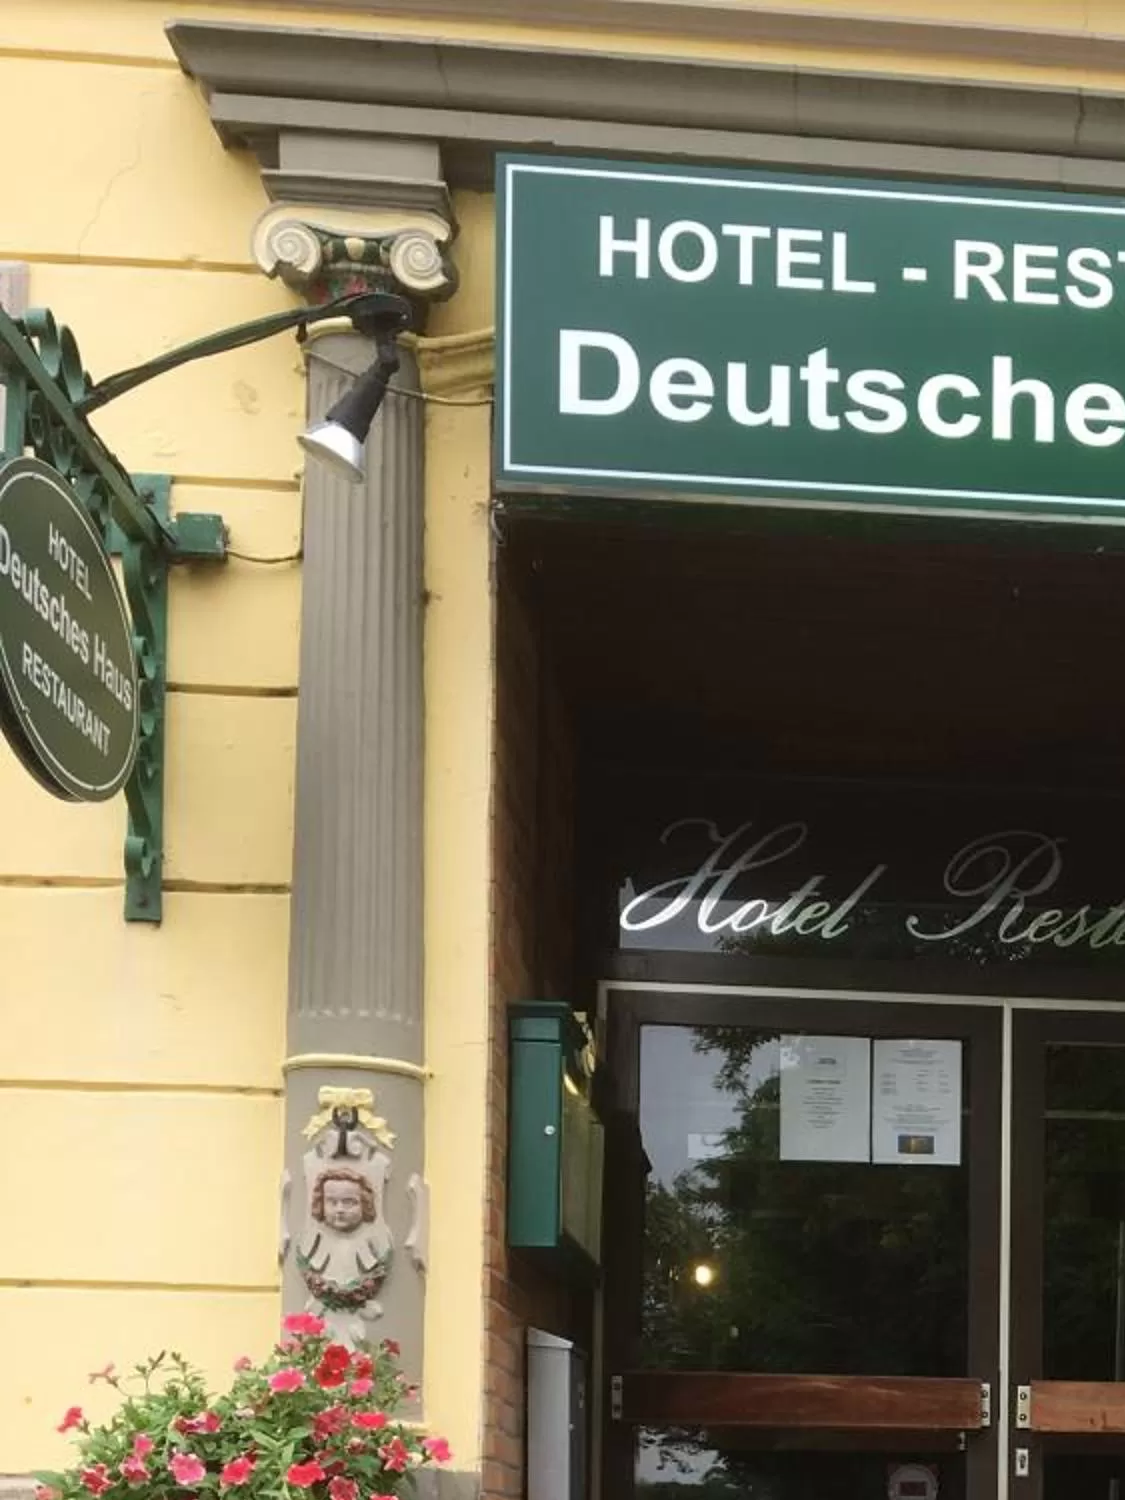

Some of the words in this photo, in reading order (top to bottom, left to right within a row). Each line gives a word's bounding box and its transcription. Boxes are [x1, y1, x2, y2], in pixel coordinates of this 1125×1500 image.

[597, 214, 876, 295] HOTEL
[48, 521, 93, 601] HOTEL
[22, 641, 112, 758] RESTAURANT
[93, 631, 133, 713] Haus
[618, 818, 889, 940] Hotel
